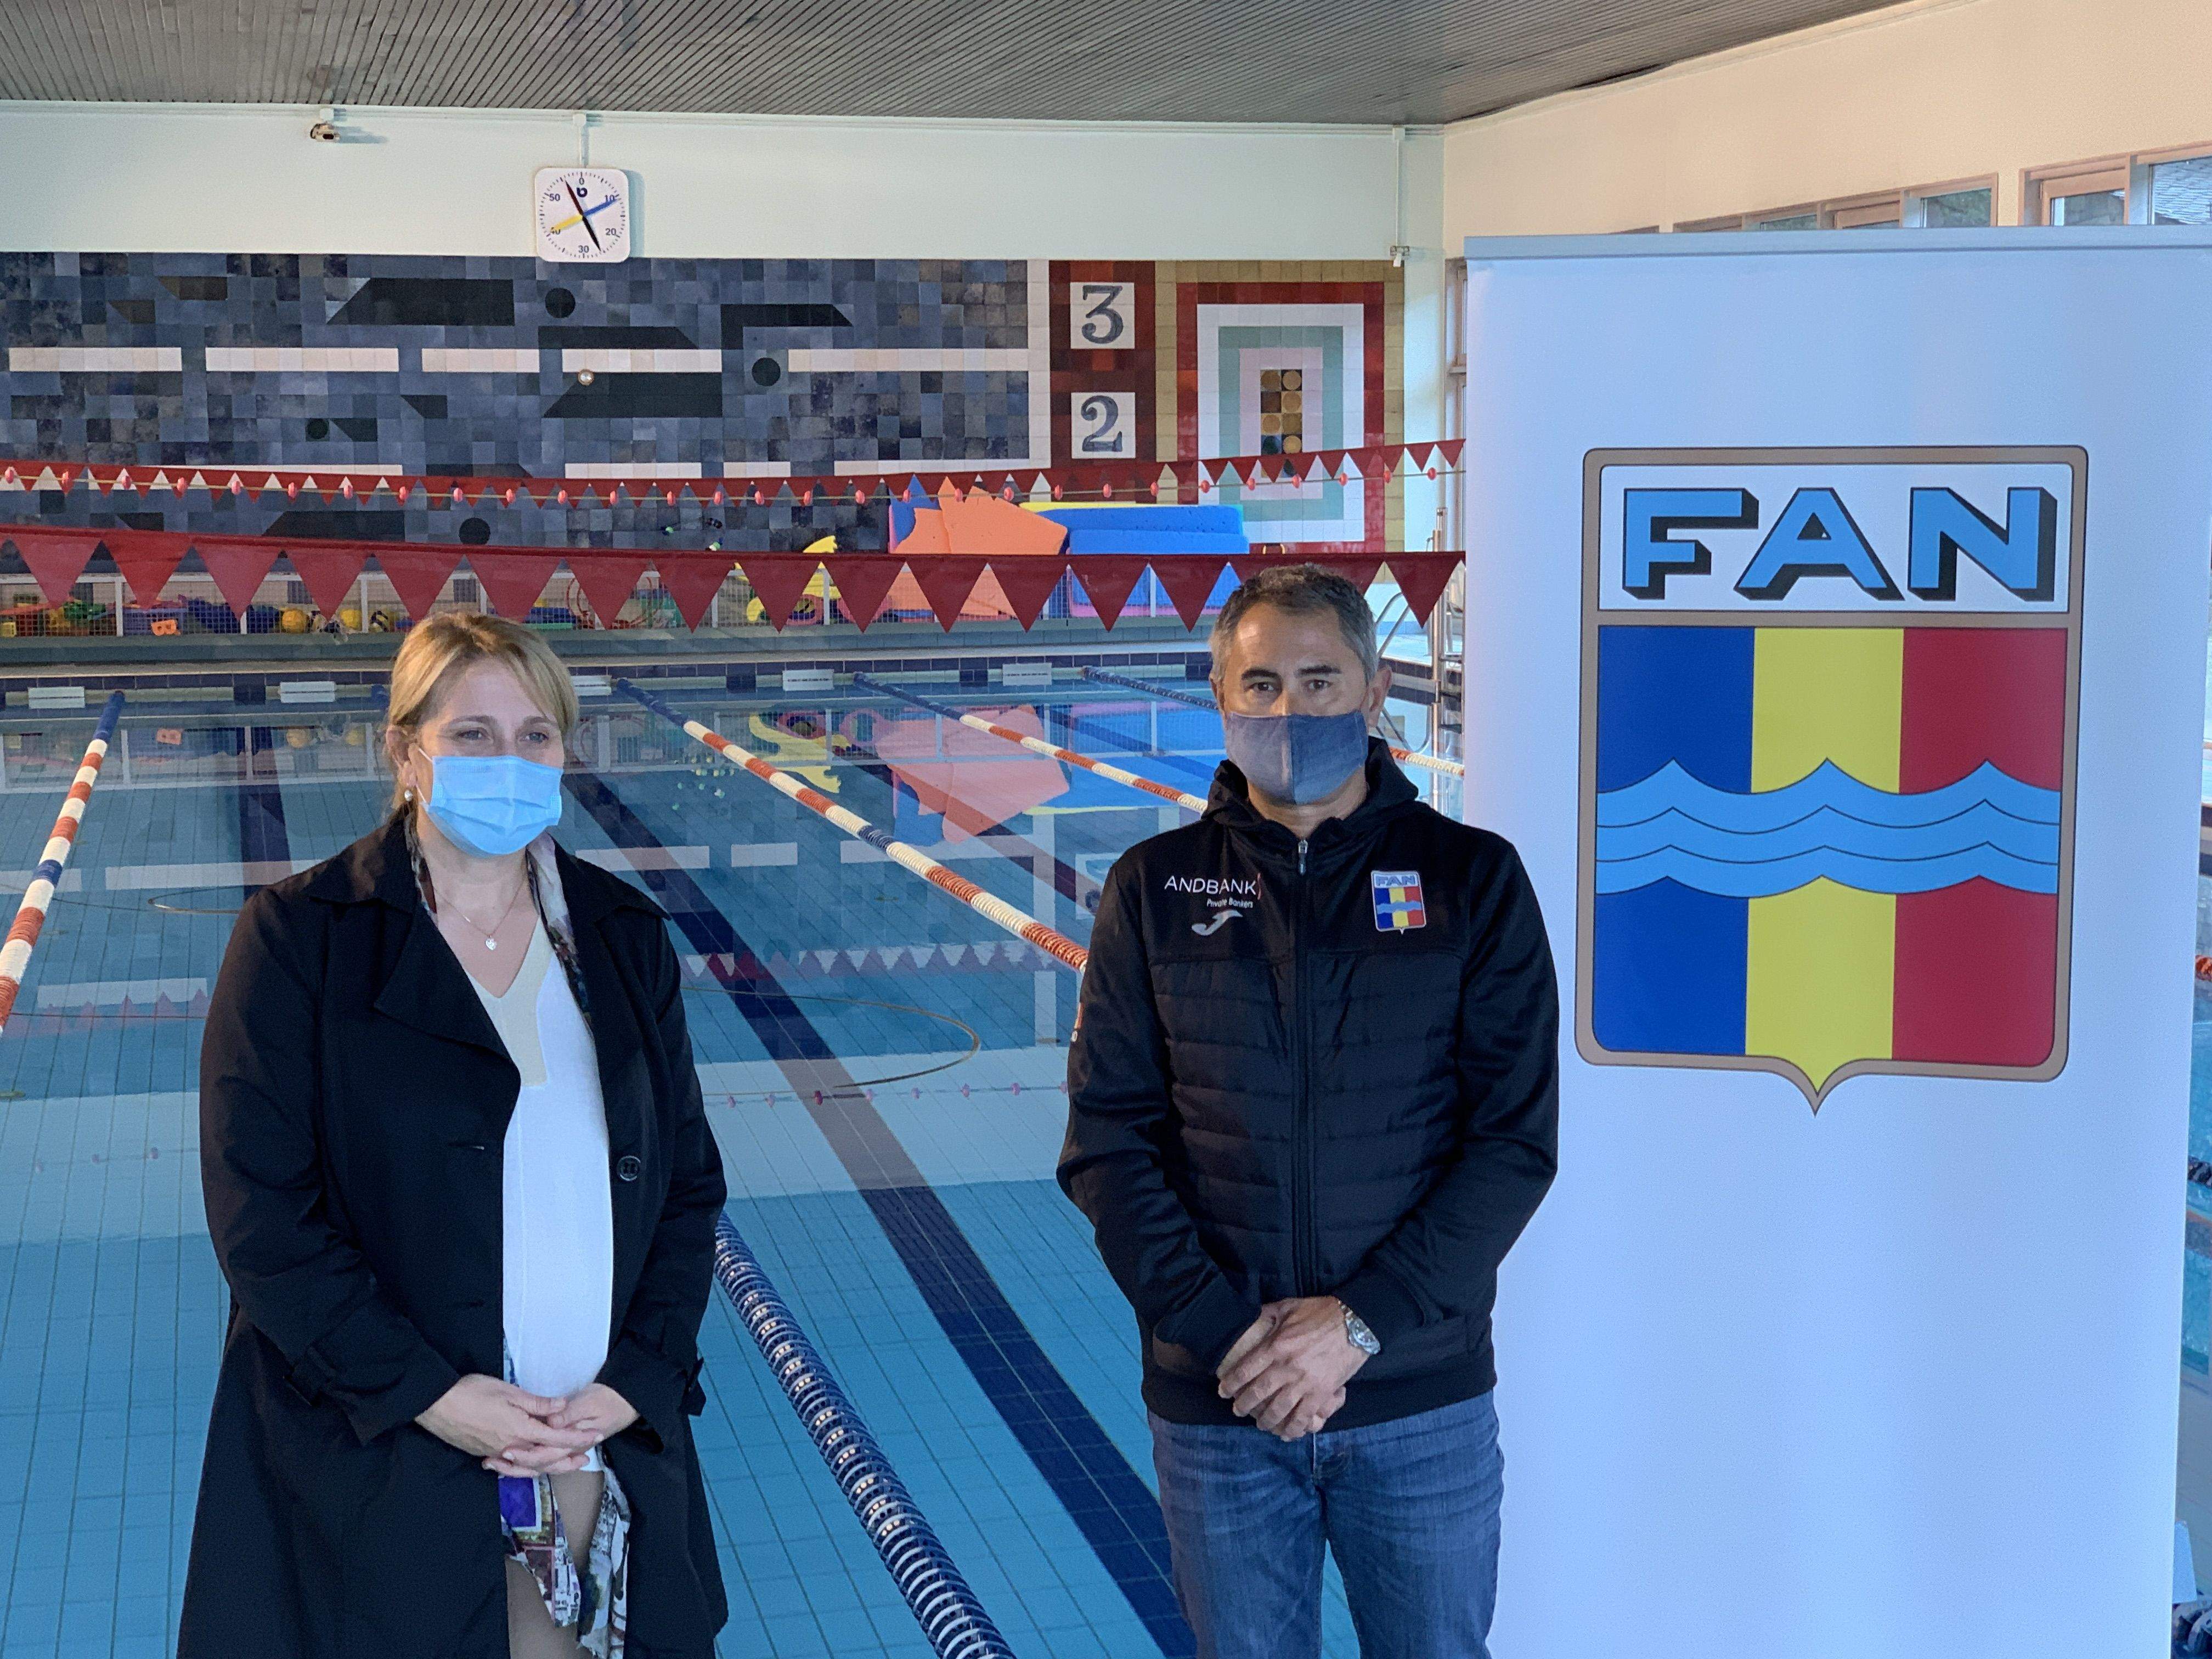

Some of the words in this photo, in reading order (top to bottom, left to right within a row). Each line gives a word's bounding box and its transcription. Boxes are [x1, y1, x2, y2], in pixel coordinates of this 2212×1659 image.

[1081, 285, 1124, 344] 3
[1081, 395, 1123, 452] 2
[1622, 487, 2058, 602] FAN
[1164, 875, 1256, 896] ANDBANK
[1375, 875, 1416, 886] FAN
